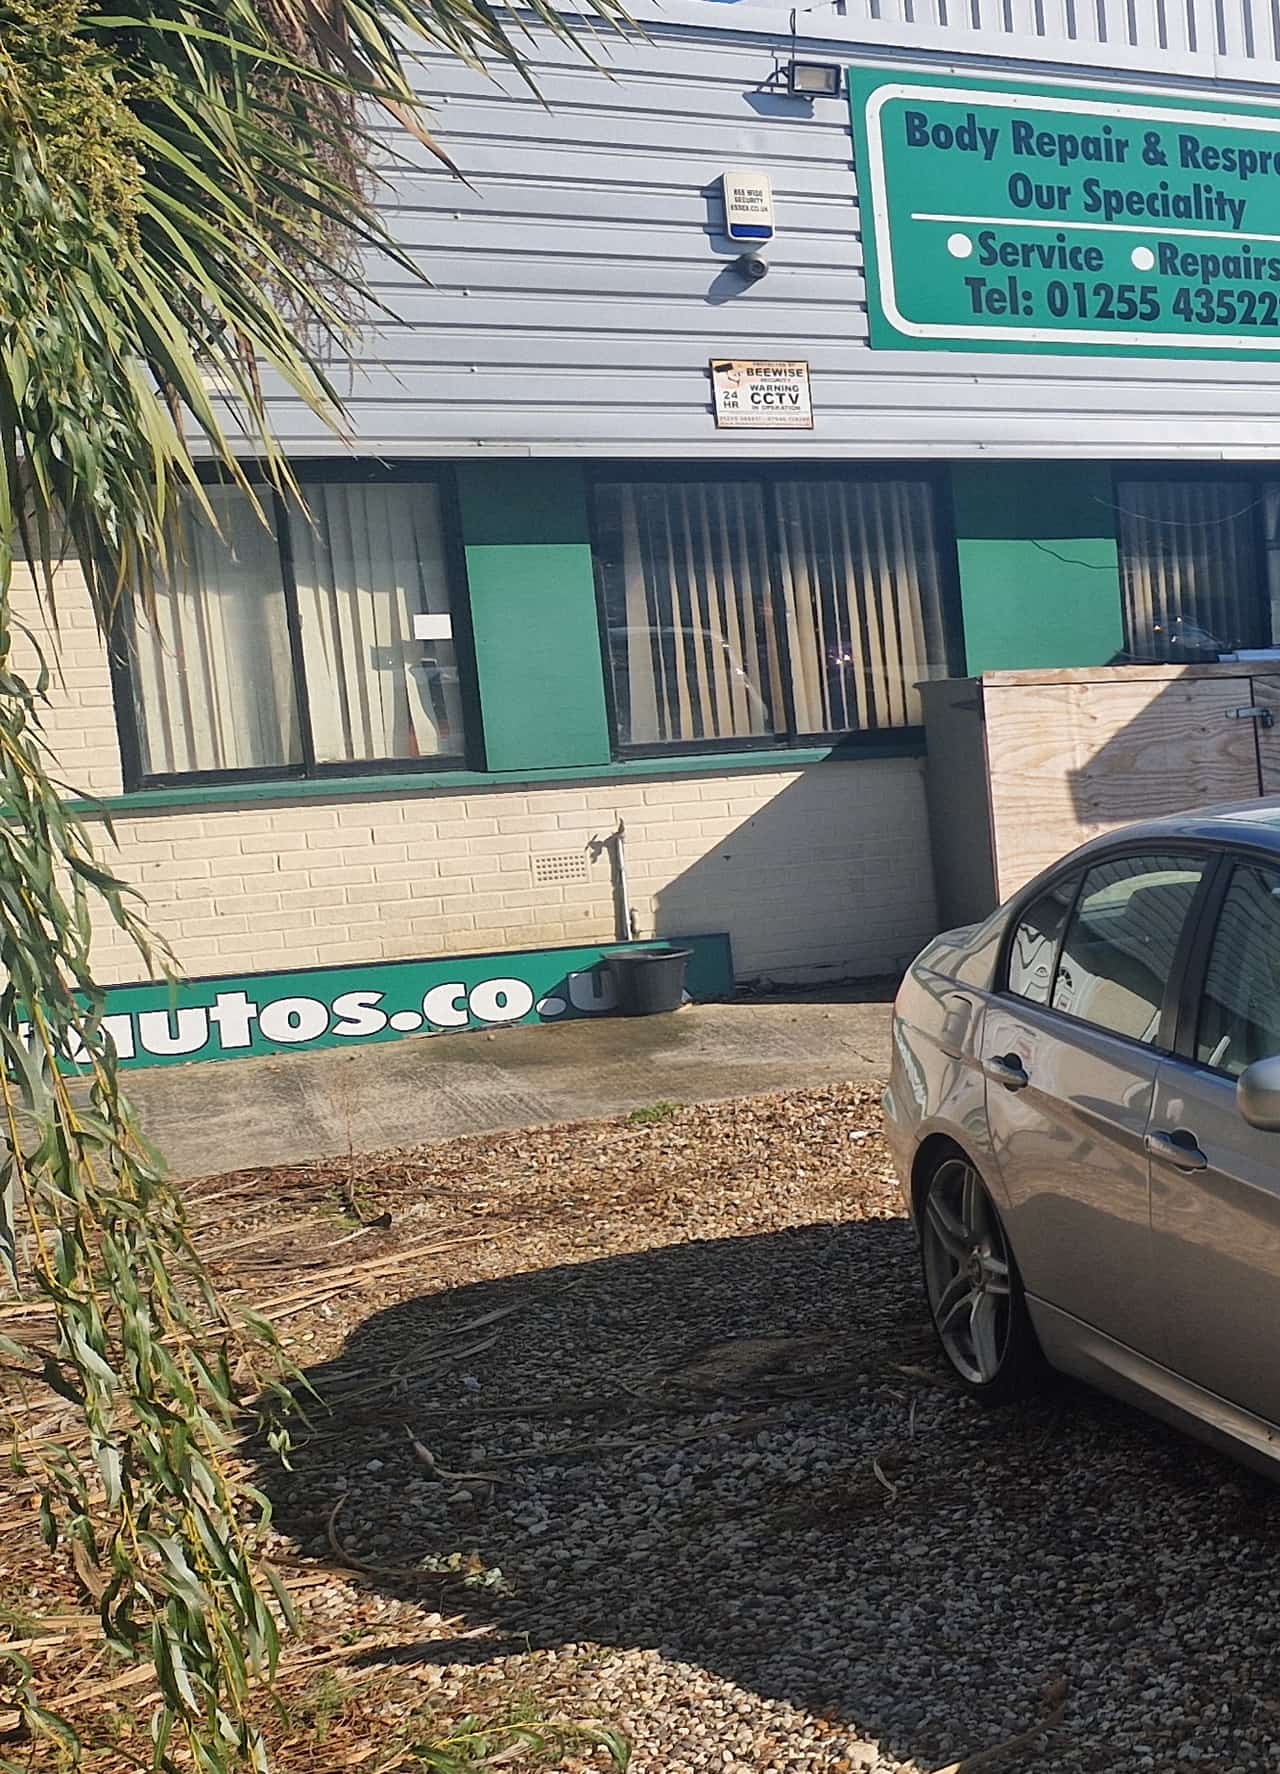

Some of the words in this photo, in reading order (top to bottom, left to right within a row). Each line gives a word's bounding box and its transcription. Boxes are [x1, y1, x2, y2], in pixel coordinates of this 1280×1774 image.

[905, 109, 1000, 161] Body
[1011, 118, 1129, 168] Repair
[1142, 131, 1169, 168] &
[1007, 171, 1073, 209] Our
[1083, 178, 1247, 230] Speciality
[978, 231, 1104, 272] Service
[964, 276, 1033, 317] Tel:
[1047, 280, 1161, 322] 01255
[746, 368, 804, 377] BEEWISE
[750, 384, 799, 392] WARNING
[723, 391, 738, 400] 24
[750, 392, 799, 405] CCTV
[723, 401, 739, 409] HR
